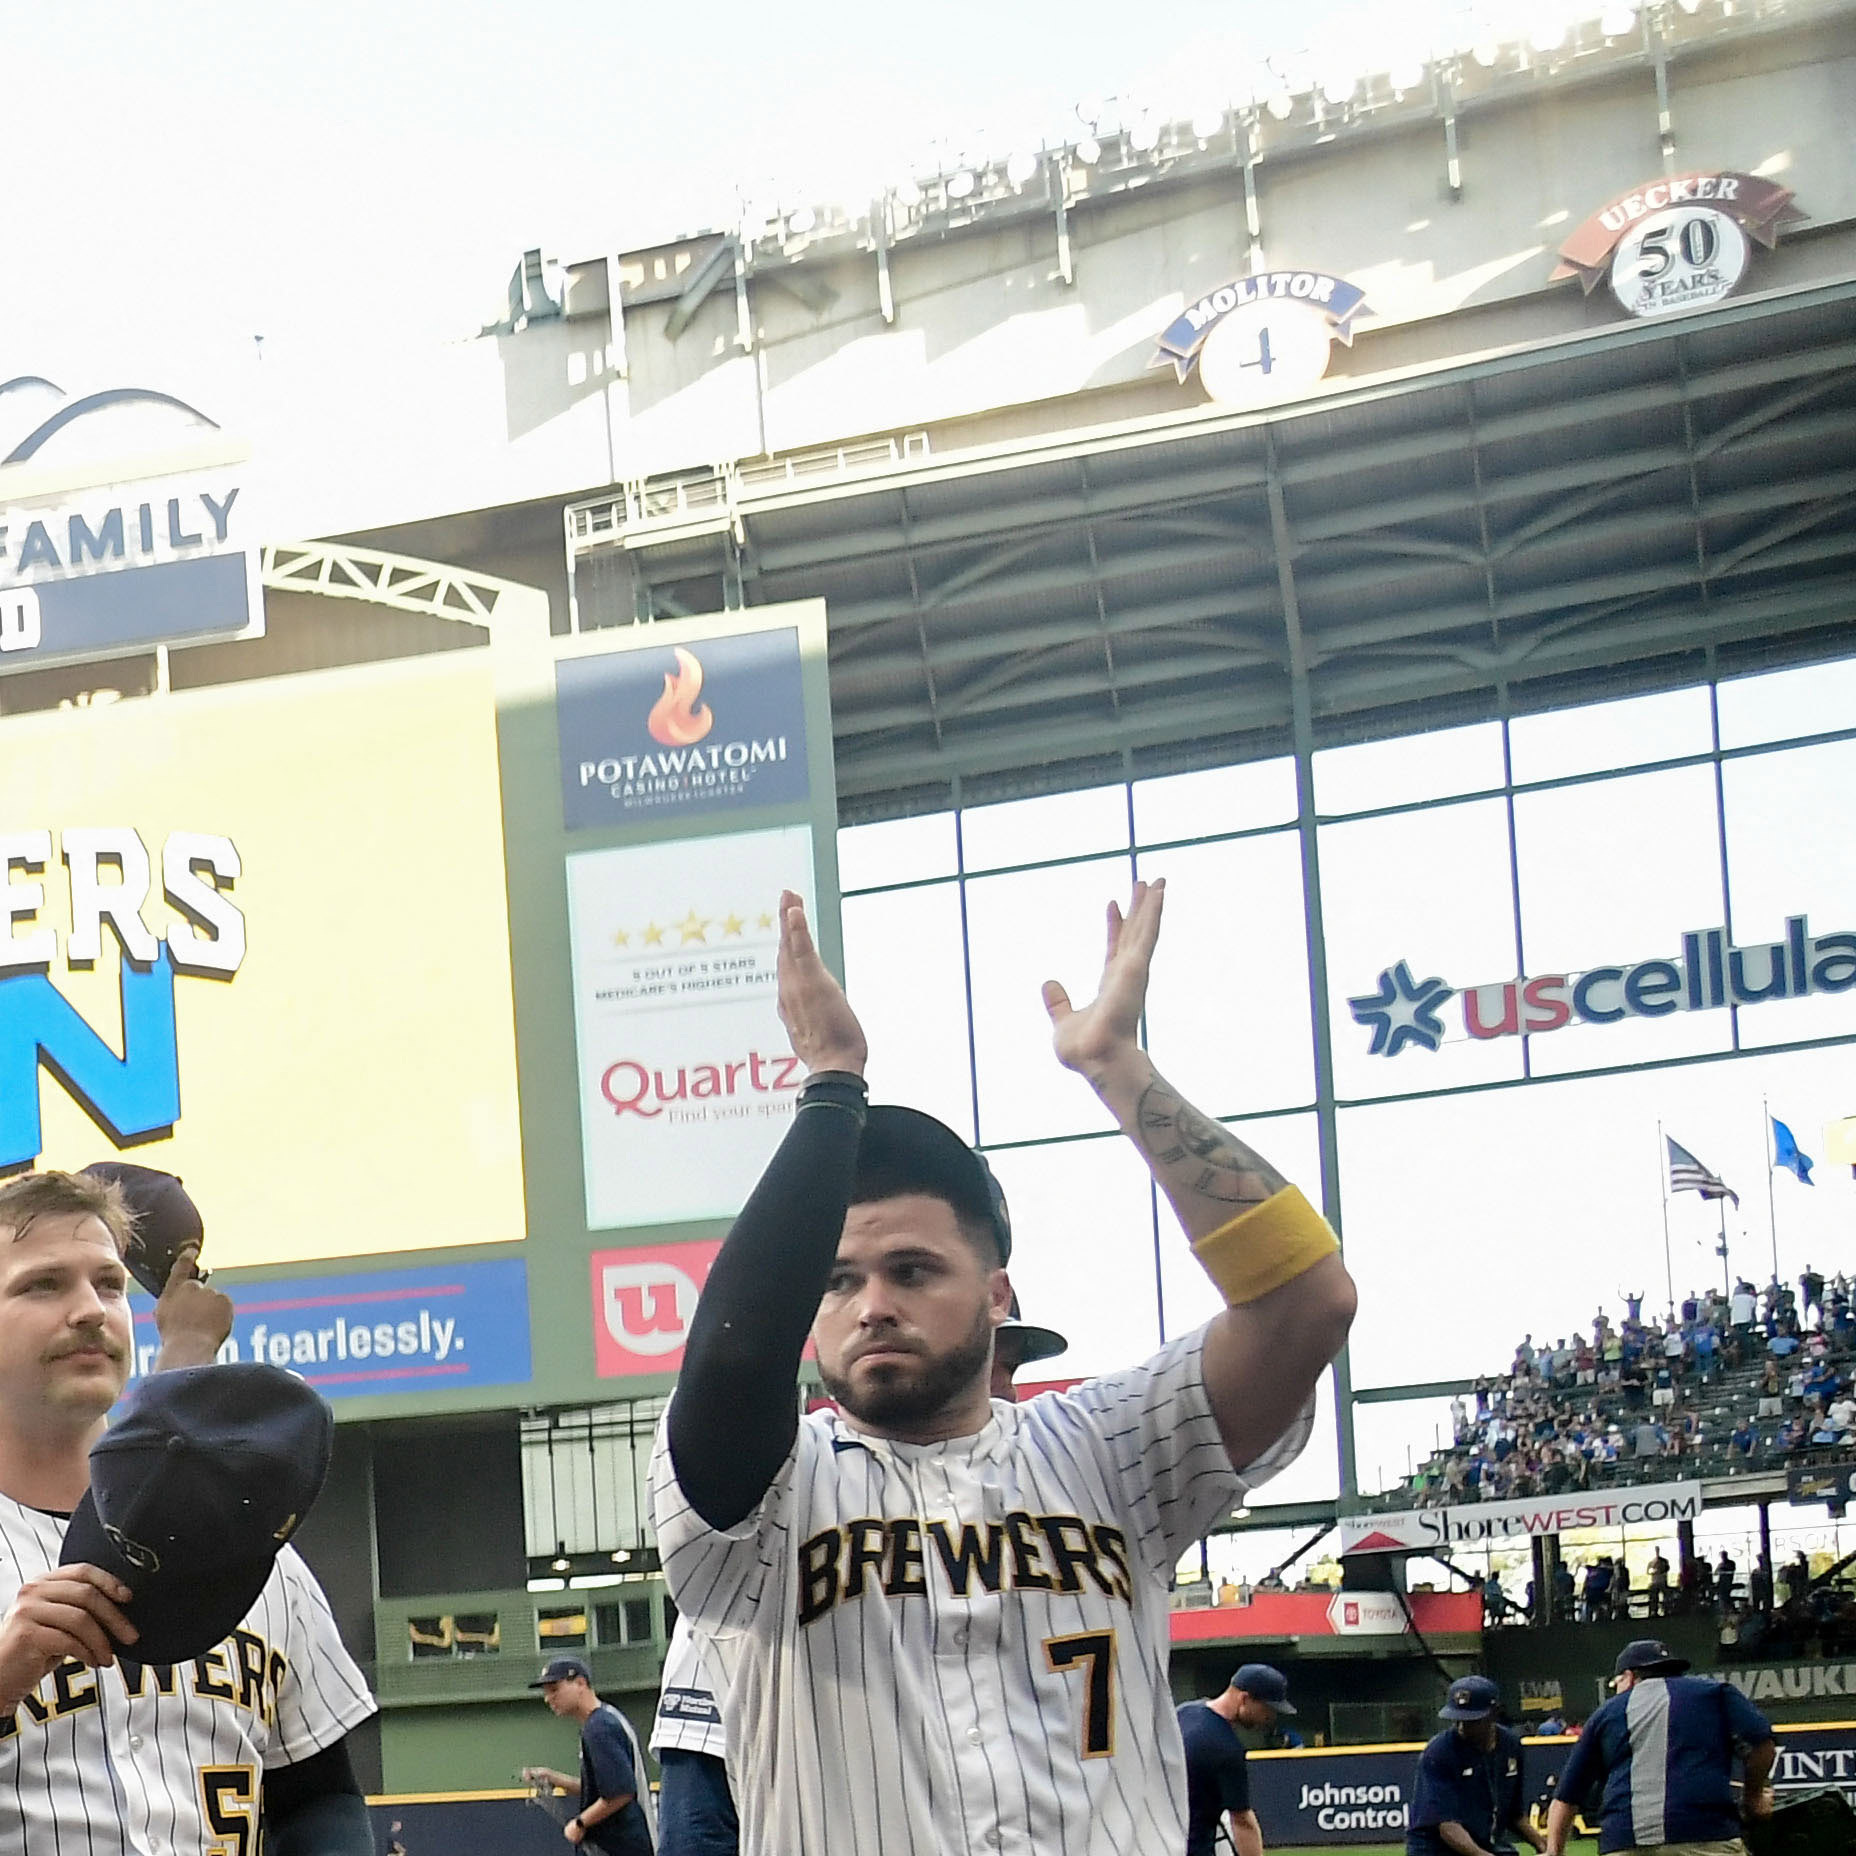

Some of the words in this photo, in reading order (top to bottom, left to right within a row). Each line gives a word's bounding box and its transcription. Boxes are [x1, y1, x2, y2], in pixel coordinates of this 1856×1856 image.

[1598, 177, 1739, 231] UECKER
[1638, 218, 1720, 279] 50
[1185, 272, 1335, 331] MOLITOR
[1641, 268, 1721, 302] YEARS
[1239, 327, 1276, 374] 4
[579, 736, 787, 787] POTAWATOMI
[610, 775, 679, 799] CASINO
[692, 767, 750, 787] HOTEL
[1463, 915, 1856, 1040] uscellula
[600, 1050, 801, 1119] Quartz
[668, 1107, 707, 1123] Find
[712, 1104, 752, 1122] your
[250, 1308, 465, 1366] fearlessly.
[614, 1283, 685, 1339] u
[798, 1511, 1134, 1629] BREWERS
[1361, 1607, 1399, 1622] TOYOTA
[1041, 1628, 1118, 1761] 7
[1298, 1782, 1401, 1810] Johnson
